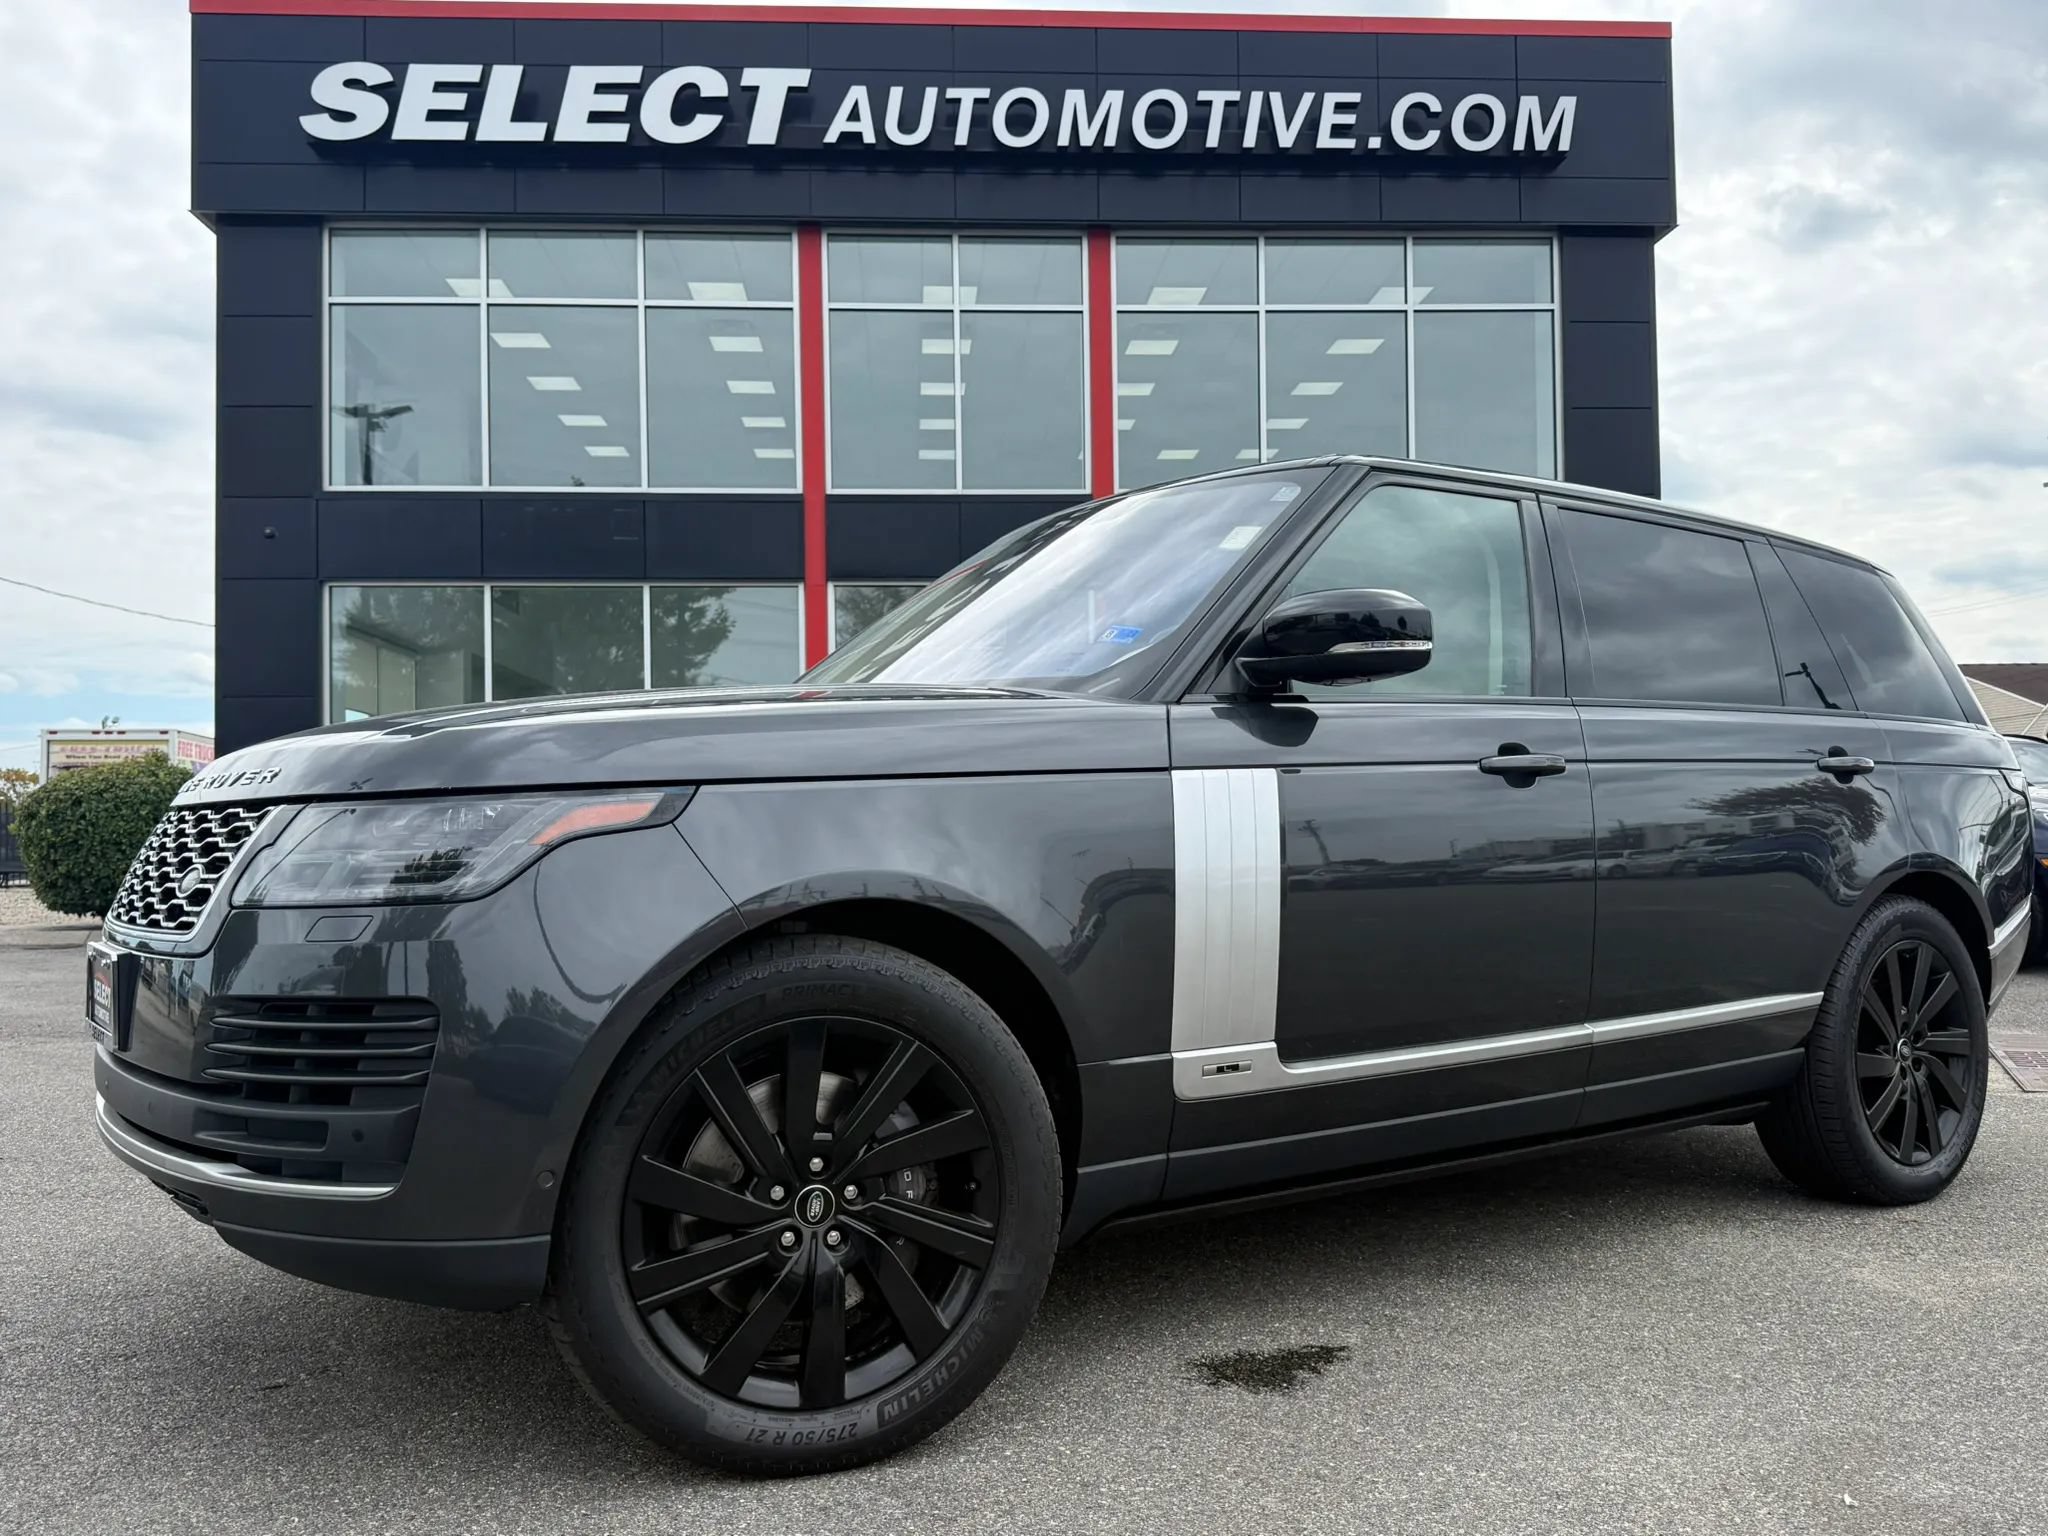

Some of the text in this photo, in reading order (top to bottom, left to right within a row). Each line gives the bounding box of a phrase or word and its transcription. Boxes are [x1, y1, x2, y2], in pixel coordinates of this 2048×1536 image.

[298, 61, 1578, 151] SELECT AUTOMOTIVE.COM
[883, 1326, 985, 1421] MICHELIN
[745, 1421, 858, 1447] 275/50 R 21
